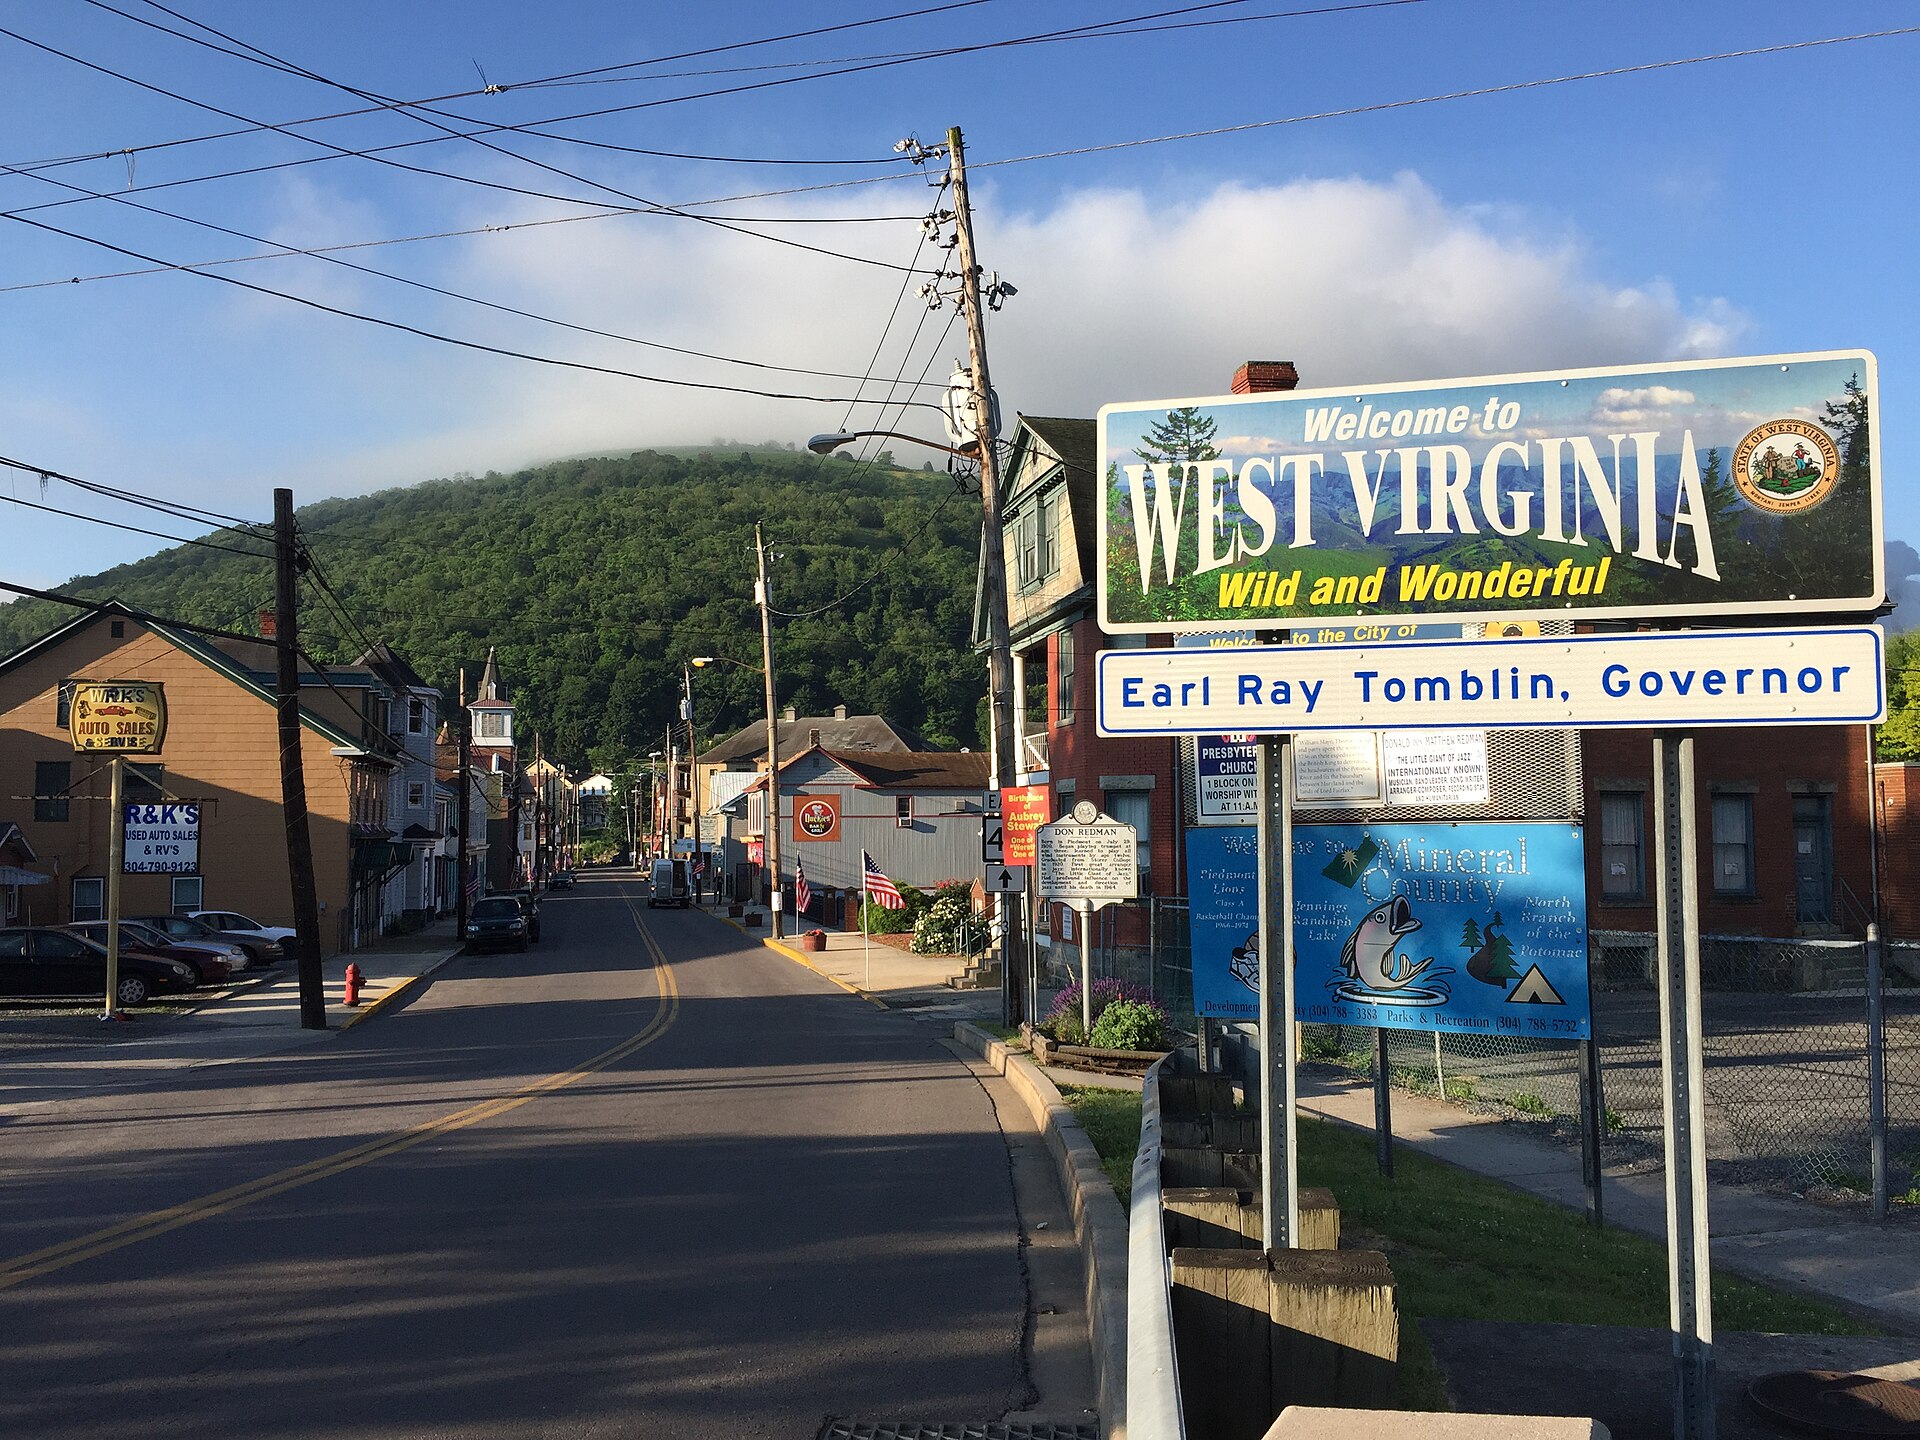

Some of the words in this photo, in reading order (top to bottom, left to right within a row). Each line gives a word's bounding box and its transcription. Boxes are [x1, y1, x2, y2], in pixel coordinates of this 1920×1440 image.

[1304, 404, 1470, 442] Welcome
[1482, 397, 1521, 430] to
[1738, 443, 1753, 473] STATE
[1752, 432, 1763, 443] OF
[1765, 424, 1801, 435] WEST
[1803, 426, 1835, 467] VIRGINIA
[1750, 490, 1774, 505] MONTANI
[1123, 453, 1325, 595] WEST
[1341, 428, 1721, 582] VIRGINIA
[1218, 570, 1303, 608] Wild
[1309, 565, 1388, 605] and
[1400, 556, 1612, 601] Wonderful
[1292, 632, 1310, 646] to
[1317, 629, 1345, 643] the
[1353, 626, 1390, 642] City
[1398, 624, 1417, 636] of
[1122, 676, 1210, 708] Earl
[1238, 674, 1324, 713] Ray
[1354, 666, 1569, 703] Tomblin,
[1602, 663, 1851, 698] Governor
[79, 722, 109, 735] AUTO
[116, 722, 155, 735] SALES
[1410, 755, 1427, 763] LITTLE
[1430, 754, 1445, 762] GIANT
[1448, 753, 1454, 762] OF
[1388, 766, 1450, 776] INTERNATIONALLY
[1214, 779, 1240, 788] BLOCK
[1242, 778, 1253, 786] ON
[1206, 790, 1241, 799] WORSHIP
[1244, 790, 1257, 798] WIT
[126, 804, 198, 824] R&K'S
[1221, 803, 1230, 811] AT
[1009, 812, 1045, 822] Aubrey
[126, 830, 147, 840] USED
[149, 830, 170, 840] AUTO
[172, 830, 198, 840] SALES
[987, 826, 1003, 851] 4
[144, 845, 151, 855] &
[156, 845, 179, 855] RV'S
[1377, 837, 1530, 875] Mineral
[125, 861, 197, 872] 304-790-9123
[1200, 869, 1256, 880] Piedmont
[1213, 883, 1245, 894] Lions
[1361, 867, 1505, 914] County
[1296, 900, 1348, 916] Jennings
[1525, 896, 1571, 908] North
[1293, 915, 1352, 929] Randolph
[1521, 911, 1577, 924] Branch
[1309, 929, 1336, 940] Lake
[1527, 926, 1541, 939] of
[1548, 927, 1572, 940] the
[1519, 944, 1583, 959] Potomac
[1205, 1000, 1259, 1014] Developmen
[1308, 1005, 1329, 1020] (304)
[1332, 1007, 1347, 1018] 788
[1387, 1010, 1414, 1023] Parks
[1420, 1012, 1428, 1023] &
[1435, 1012, 1490, 1028] Recreation
[1496, 1016, 1521, 1032] (304)
[1527, 1018, 1577, 1032] 788-5732
